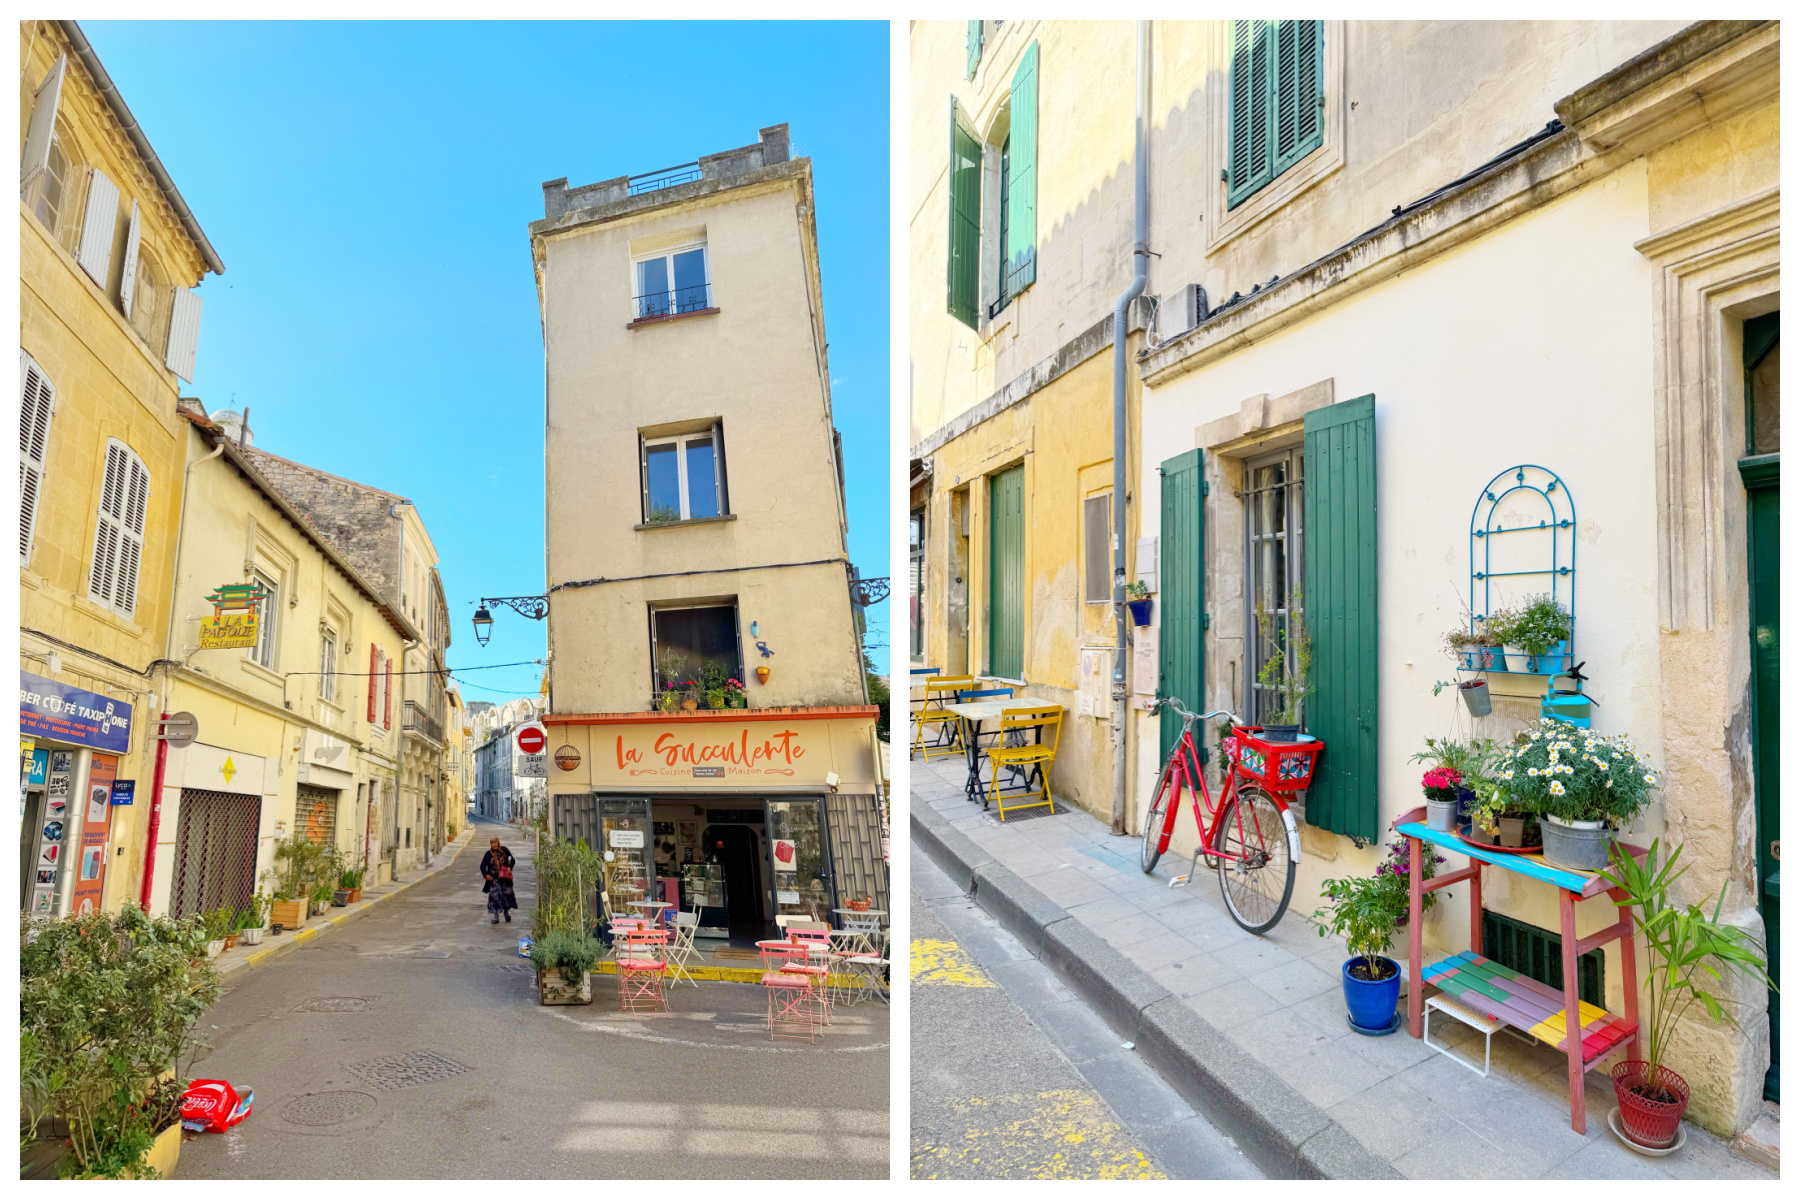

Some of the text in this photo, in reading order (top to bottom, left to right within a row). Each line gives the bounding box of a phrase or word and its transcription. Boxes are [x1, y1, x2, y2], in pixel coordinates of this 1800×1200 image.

[225, 615, 242, 627] LA
[201, 624, 255, 638] PAGODE
[200, 638, 255, 649] Restaurant
[39, 722, 49, 730] FAX
[616, 729, 806, 770] La Succulente
[659, 767, 691, 776] Cuisine
[728, 766, 762, 776] Maison
